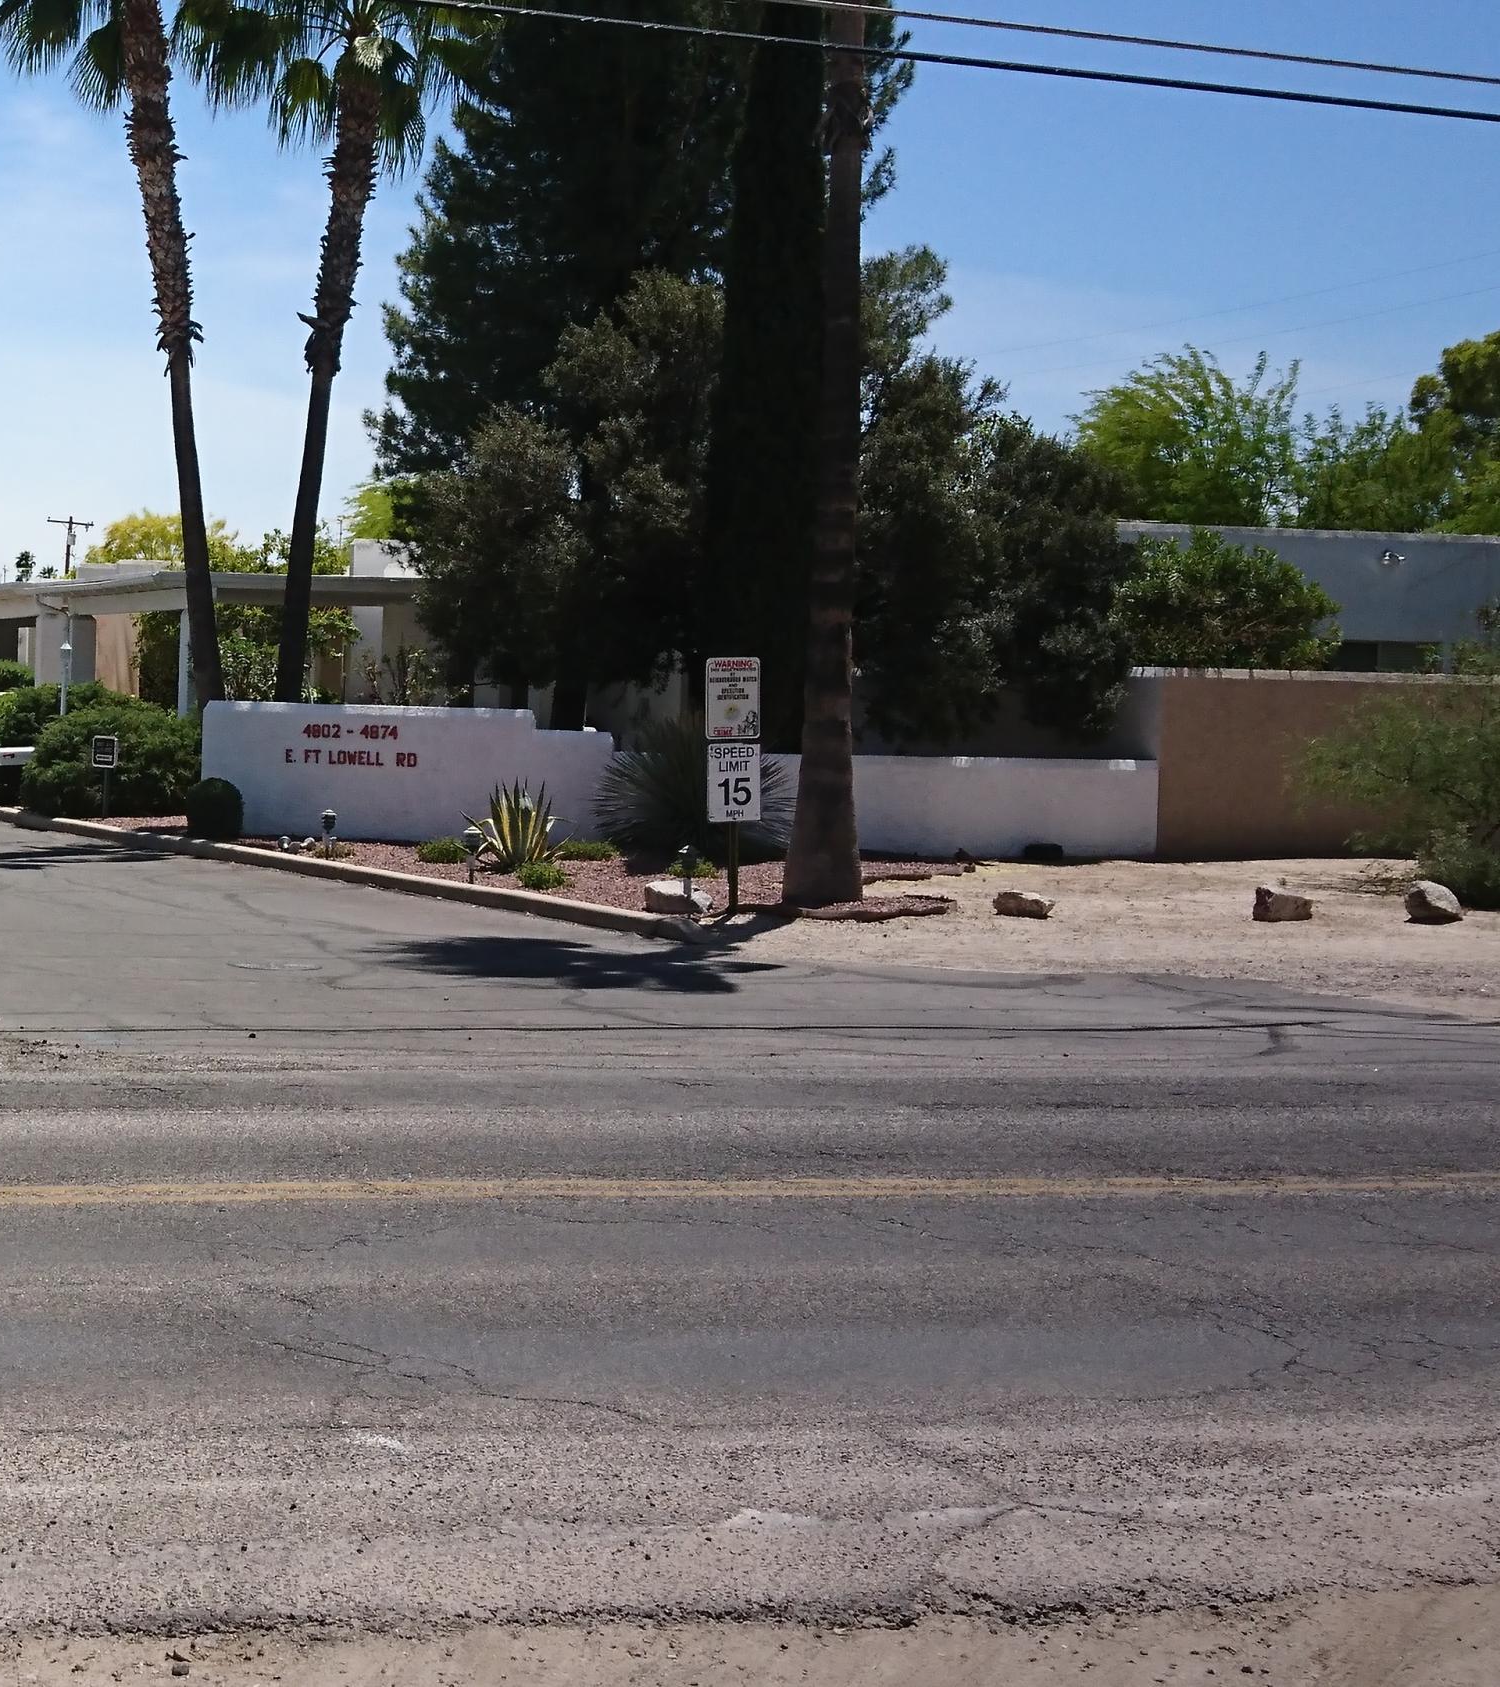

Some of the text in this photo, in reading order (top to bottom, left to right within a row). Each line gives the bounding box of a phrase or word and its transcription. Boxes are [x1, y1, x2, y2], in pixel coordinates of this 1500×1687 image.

[713, 660, 753, 668] WARNING
[303, 723, 341, 739] 4802
[359, 724, 399, 740] 4874
[285, 748, 418, 768] E. FT LOWELL RD
[714, 746, 755, 759] SPEED
[718, 760, 750, 772] LIMIT
[717, 777, 752, 806] 15
[725, 809, 744, 818] MPH
